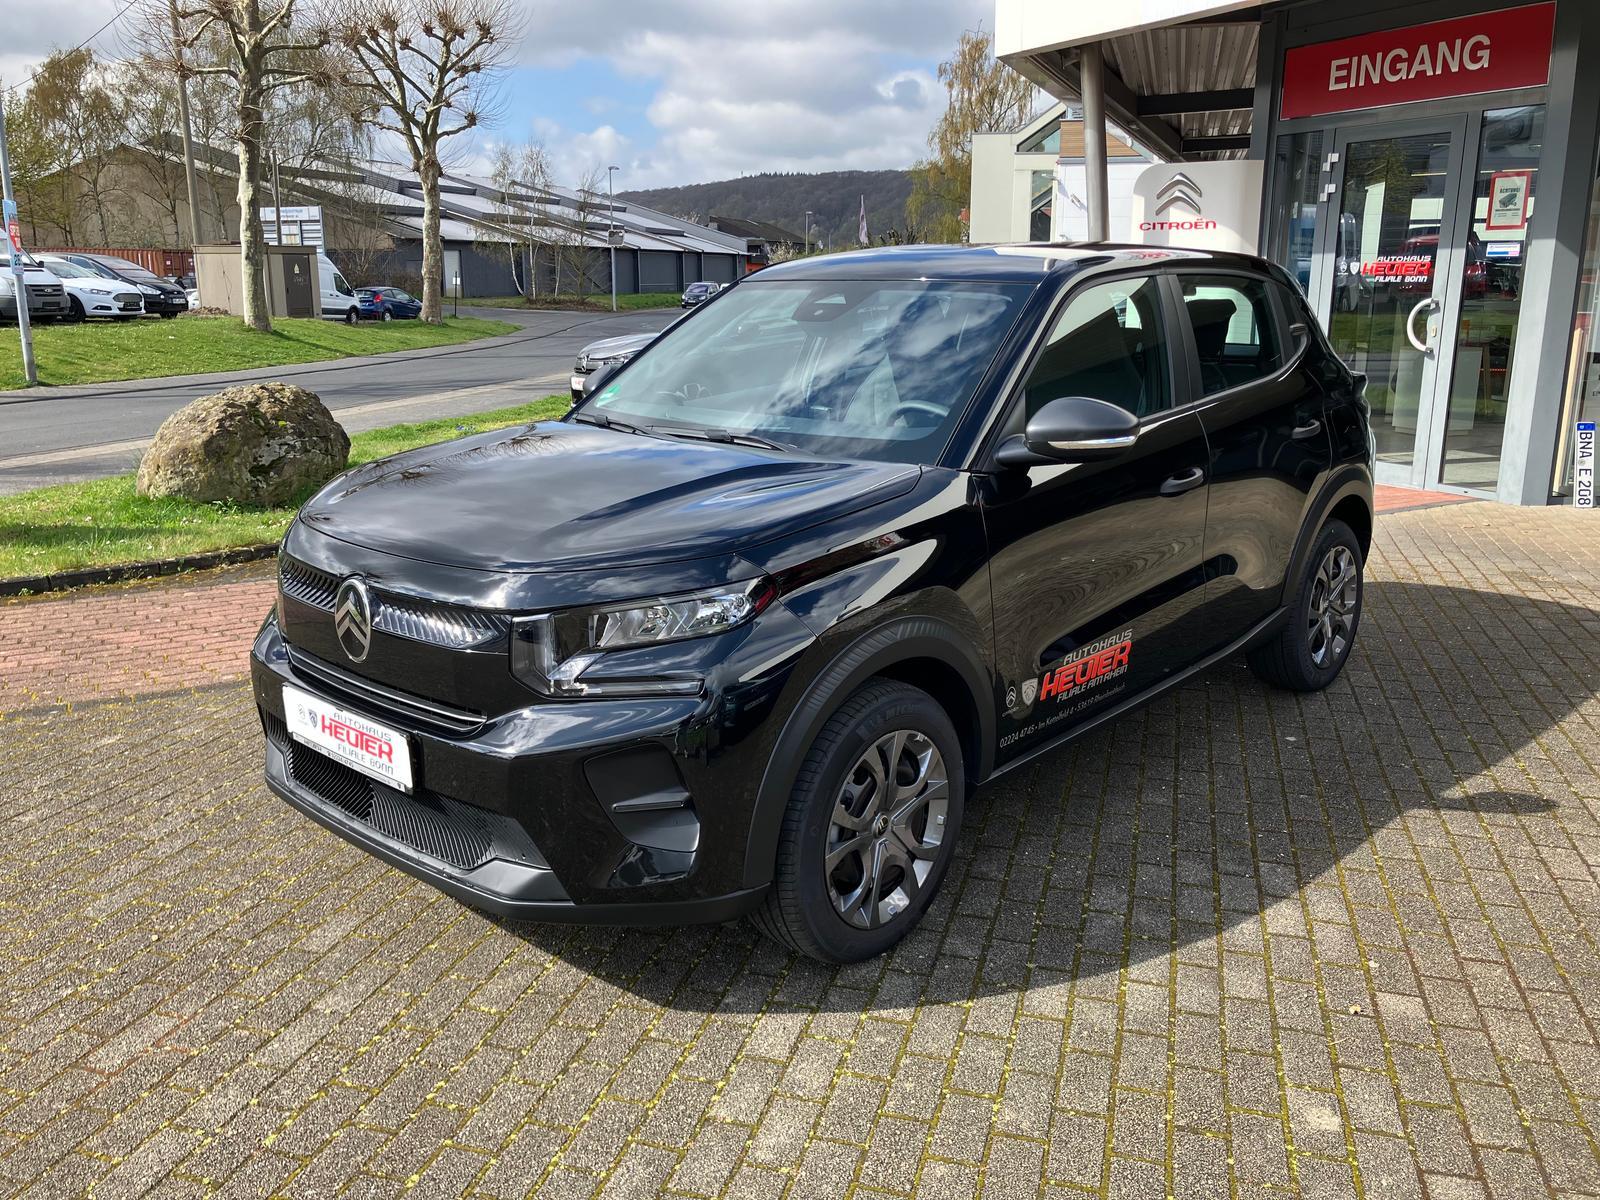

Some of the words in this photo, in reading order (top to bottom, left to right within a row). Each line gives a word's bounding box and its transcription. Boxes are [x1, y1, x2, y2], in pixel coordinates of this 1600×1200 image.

[1328, 34, 1490, 92] EINGANG
[1361, 261, 1432, 276] HEUTER
[1579, 432, 1592, 458] BNA
[1578, 481, 1591, 505] 208
[1063, 629, 1133, 665] AUTOHAUS
[1040, 639, 1132, 701] HEUTER
[1057, 681, 1087, 703] FILIALE
[1087, 675, 1104, 689] AM
[1103, 664, 1128, 682] RHEIN
[321, 714, 393, 764] HEUTER
[333, 712, 392, 742] AUTOHAUS
[999, 731, 1019, 748] 02224
[338, 743, 366, 764] FILIALE
[369, 758, 394, 775] BONN
